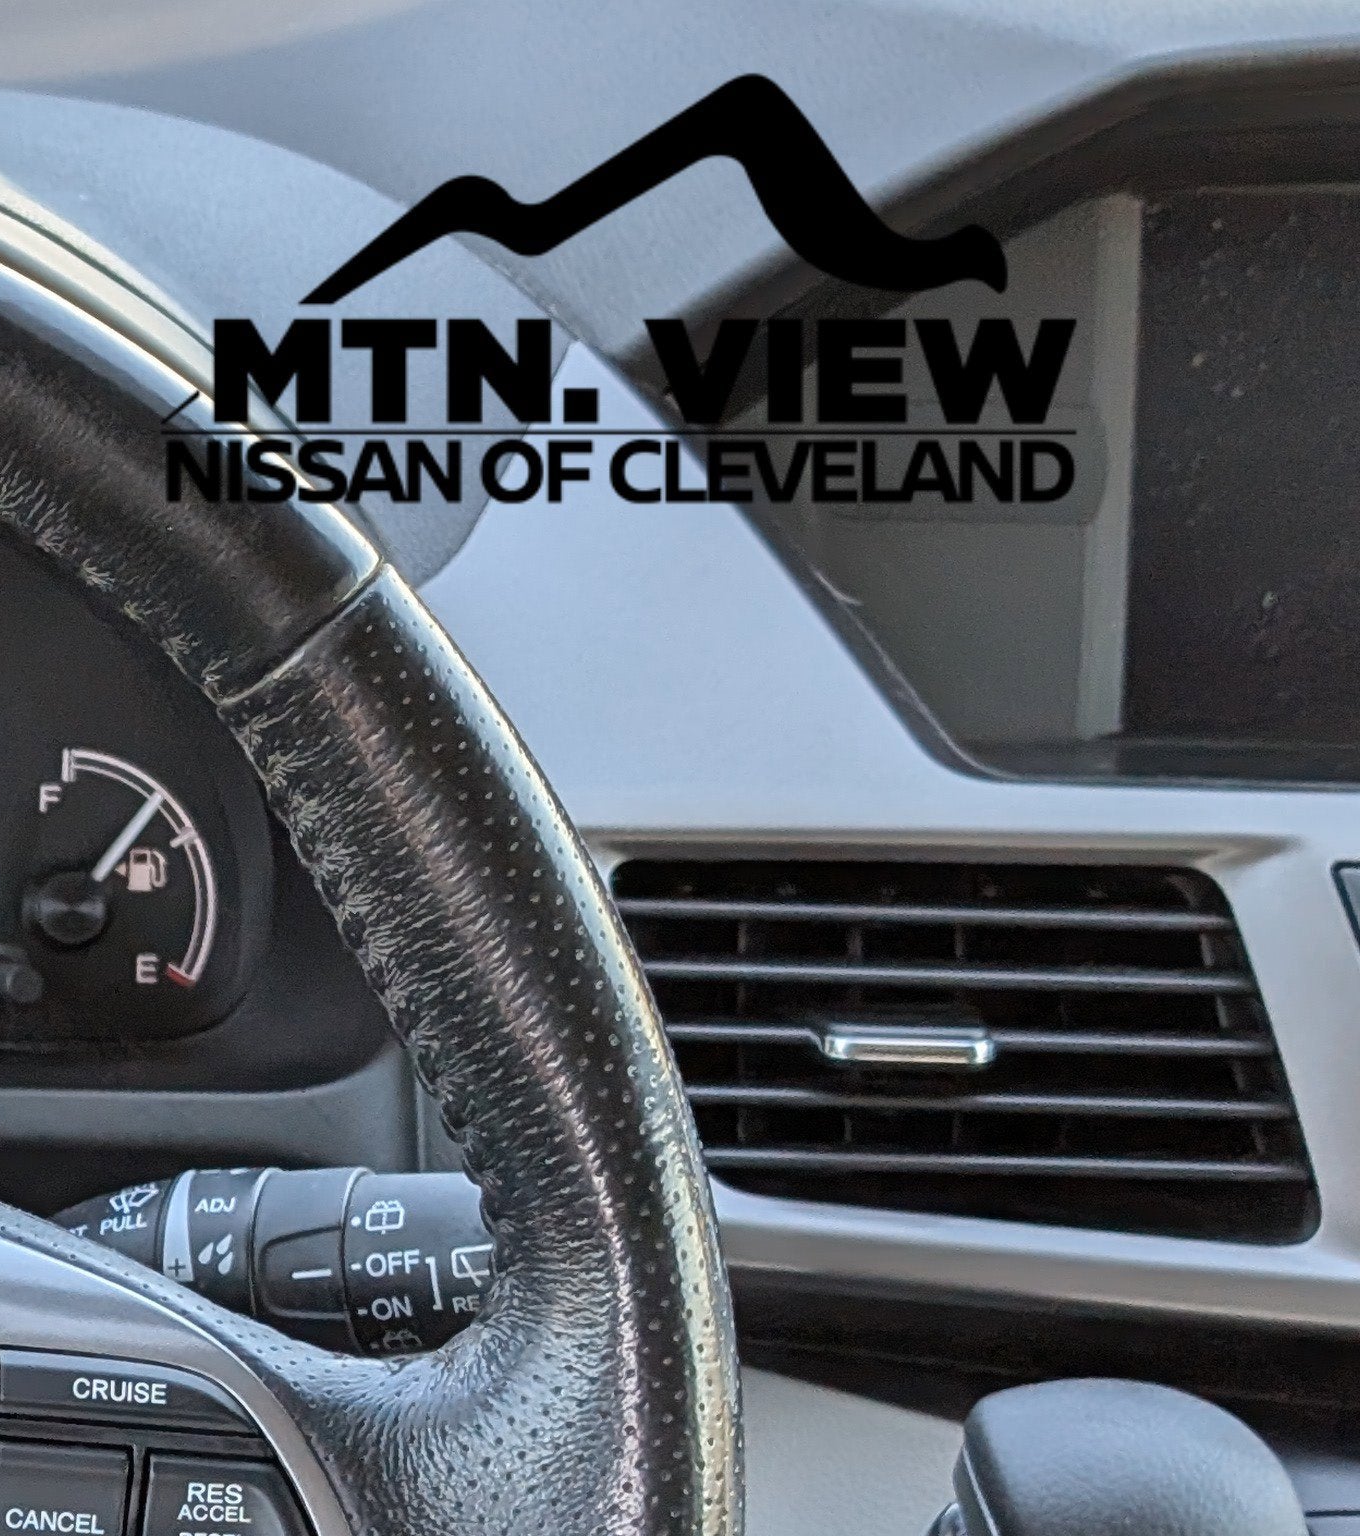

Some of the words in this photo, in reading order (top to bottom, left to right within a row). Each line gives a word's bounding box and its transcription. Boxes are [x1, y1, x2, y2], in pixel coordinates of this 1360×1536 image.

[38, 783, 63, 813] F
[135, 952, 159, 985] E
[194, 1196, 237, 1215] ADJ
[99, 1206, 148, 1238] PULL
[365, 1249, 422, 1279] OFF
[371, 1297, 413, 1323] ON
[71, 1376, 169, 1406] CRUISE
[185, 1482, 244, 1504] RES
[4, 1507, 106, 1536] CANCEL
[176, 1504, 253, 1524] ACCEL
